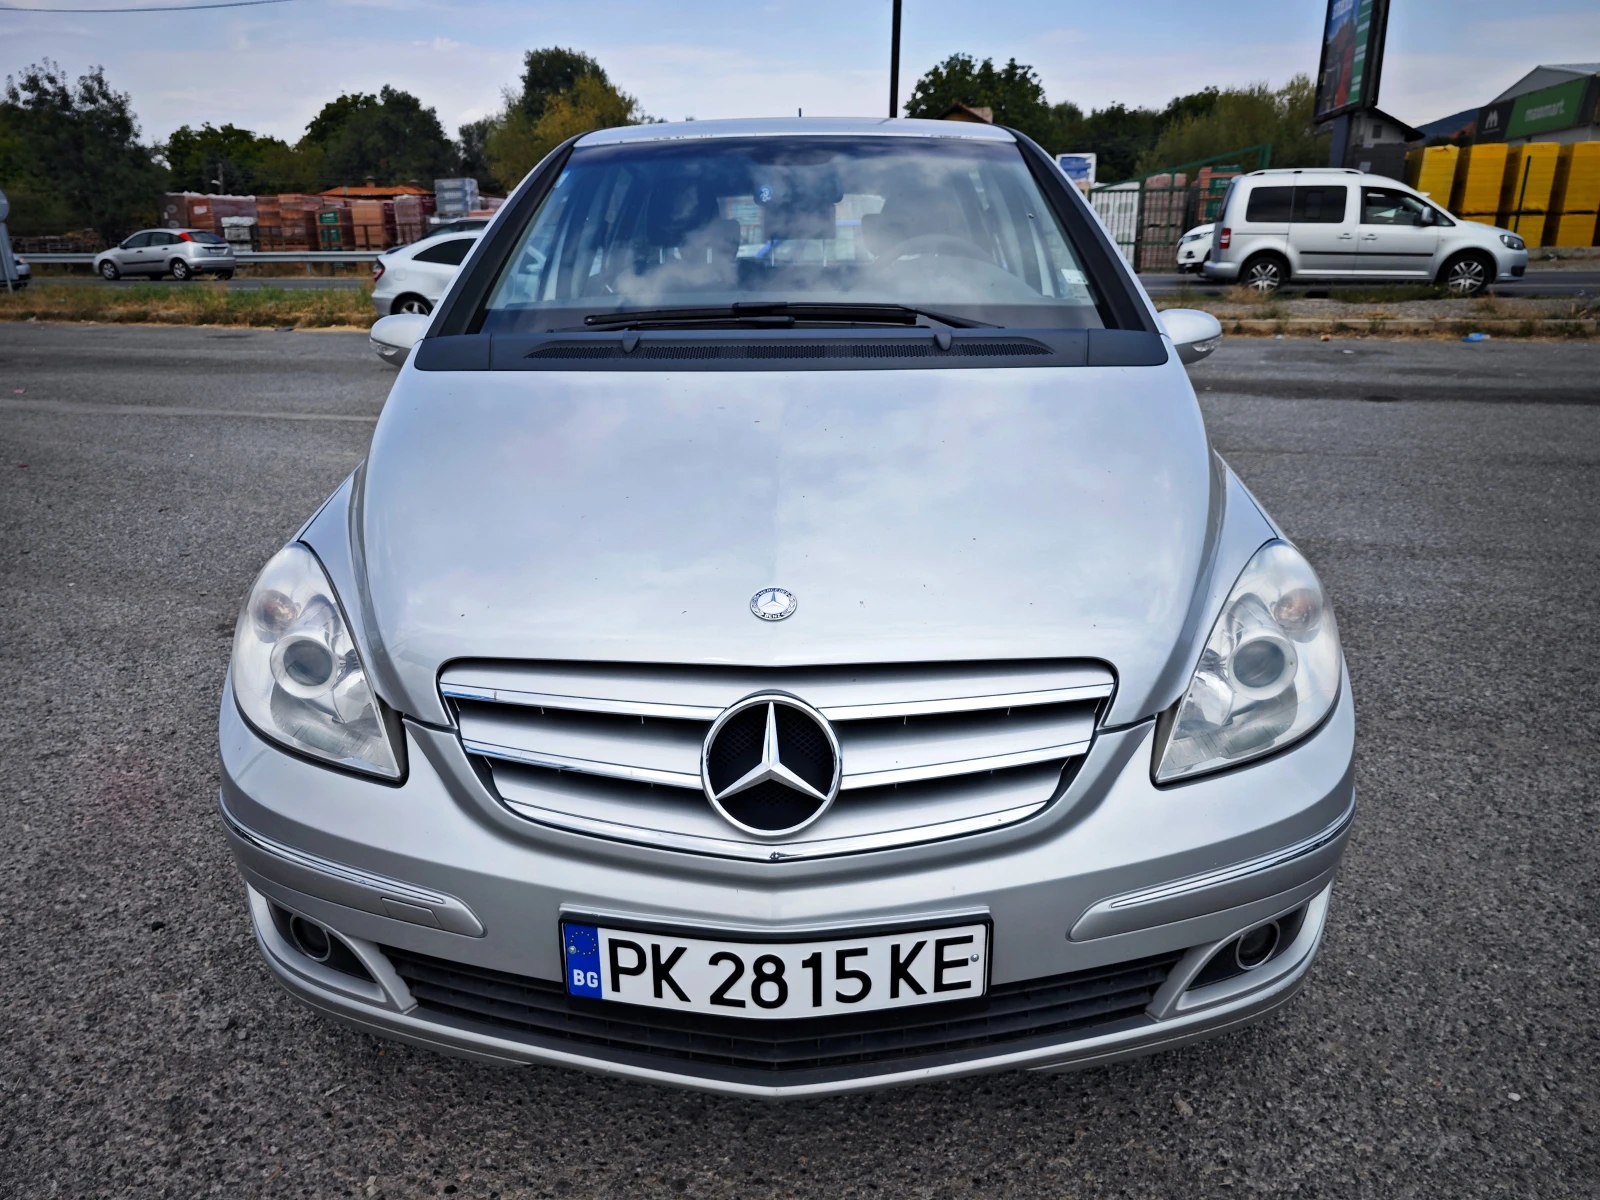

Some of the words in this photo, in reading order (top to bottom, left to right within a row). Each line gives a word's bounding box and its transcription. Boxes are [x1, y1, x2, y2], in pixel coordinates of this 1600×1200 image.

[573, 968, 599, 988] BG
[607, 937, 692, 1003] PK
[708, 947, 872, 1010] 2815
[889, 934, 974, 999] KE
